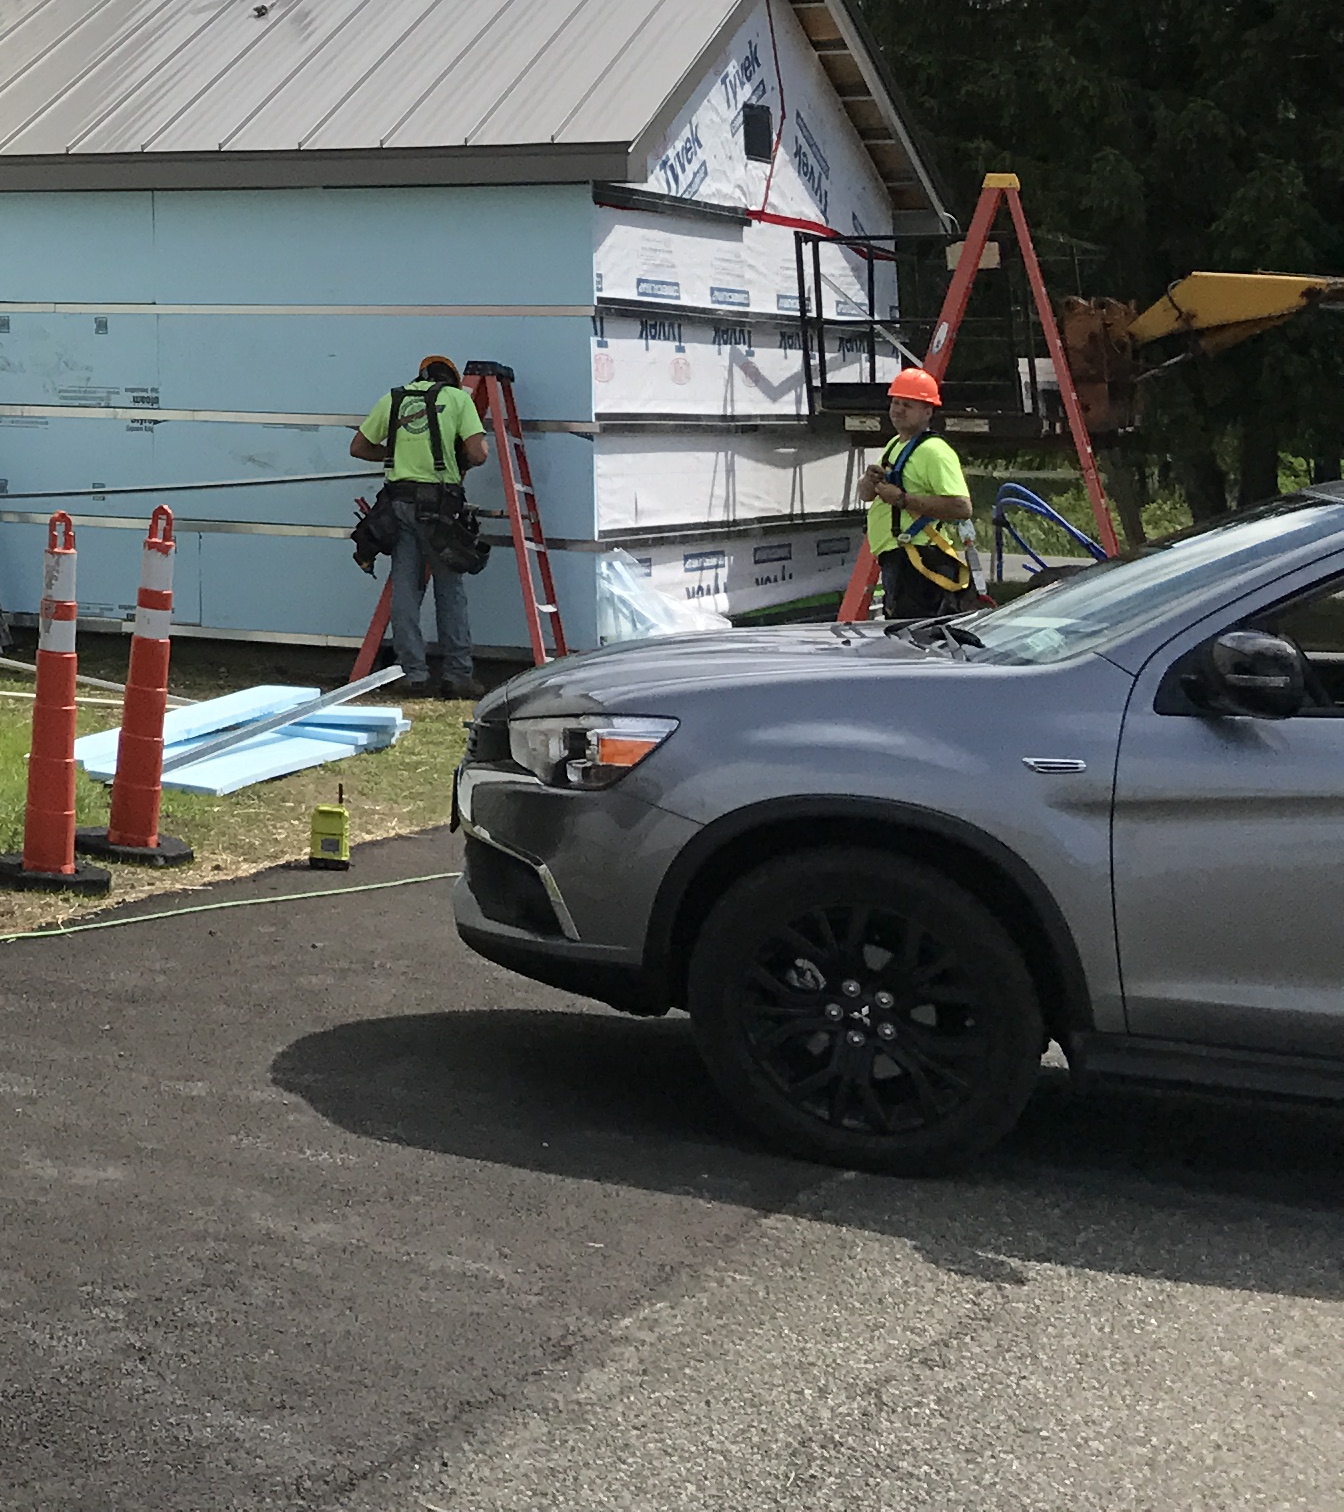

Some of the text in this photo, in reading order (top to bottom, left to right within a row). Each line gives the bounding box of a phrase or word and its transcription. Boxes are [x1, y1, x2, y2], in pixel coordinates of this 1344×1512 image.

[720, 39, 761, 110] Tyvek
[659, 118, 703, 195] Tyvek
[794, 135, 829, 226] Tyvek
